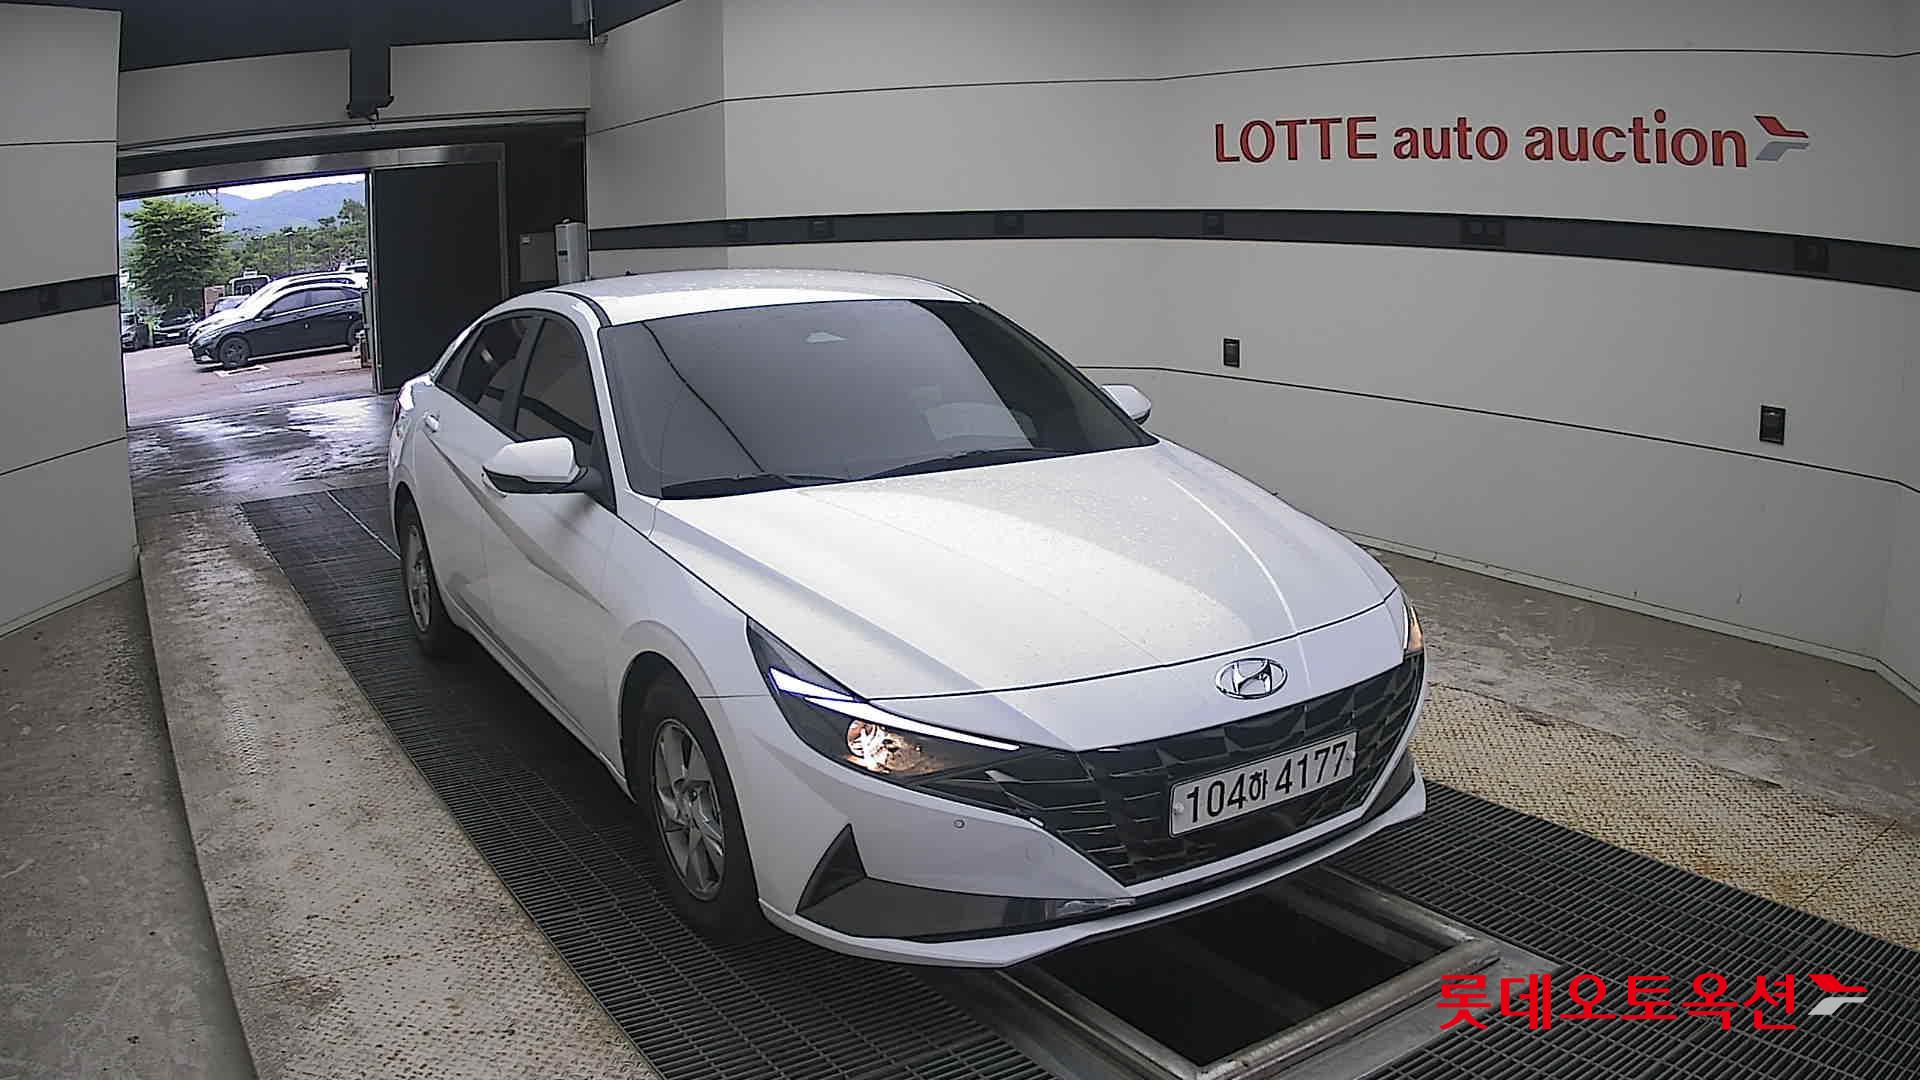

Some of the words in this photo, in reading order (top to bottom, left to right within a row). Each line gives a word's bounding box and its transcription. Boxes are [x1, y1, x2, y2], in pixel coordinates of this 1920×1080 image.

[1214, 115, 1378, 163] LOTTE
[1392, 116, 1509, 161] auto
[1523, 108, 1748, 168] auction
[1186, 769, 1269, 823] 104하
[1275, 741, 1348, 794] 4177
